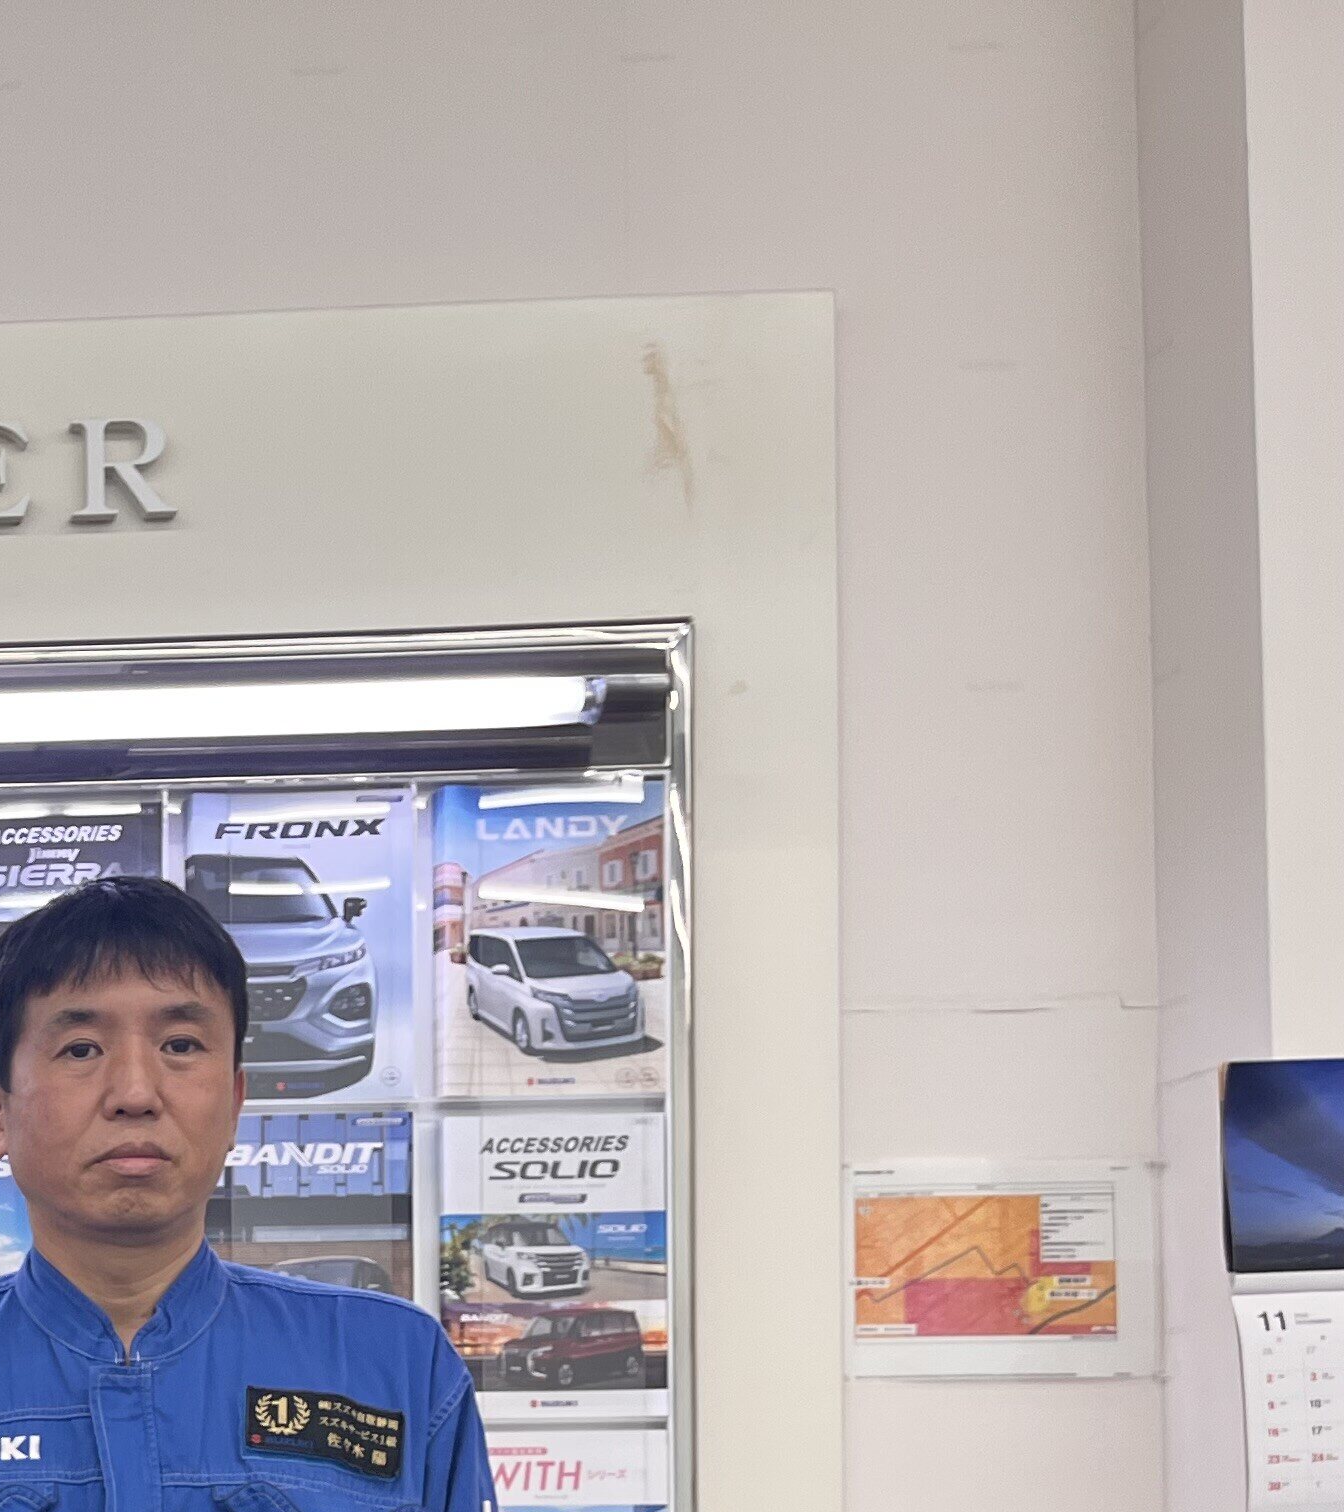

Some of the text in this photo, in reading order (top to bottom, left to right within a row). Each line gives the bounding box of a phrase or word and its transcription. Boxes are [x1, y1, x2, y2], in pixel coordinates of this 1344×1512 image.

[214, 817, 386, 840] FRONX
[476, 814, 627, 841] LANDY
[224, 1141, 384, 1167] BANDIT
[481, 1134, 630, 1155] ACCESSORIES
[316, 1164, 368, 1175] SOLIO
[489, 1159, 620, 1180] SOLIO
[1258, 1310, 1287, 1331] 11
[271, 1396, 288, 1425] 1
[587, 1467, 628, 1481] シリーズ
